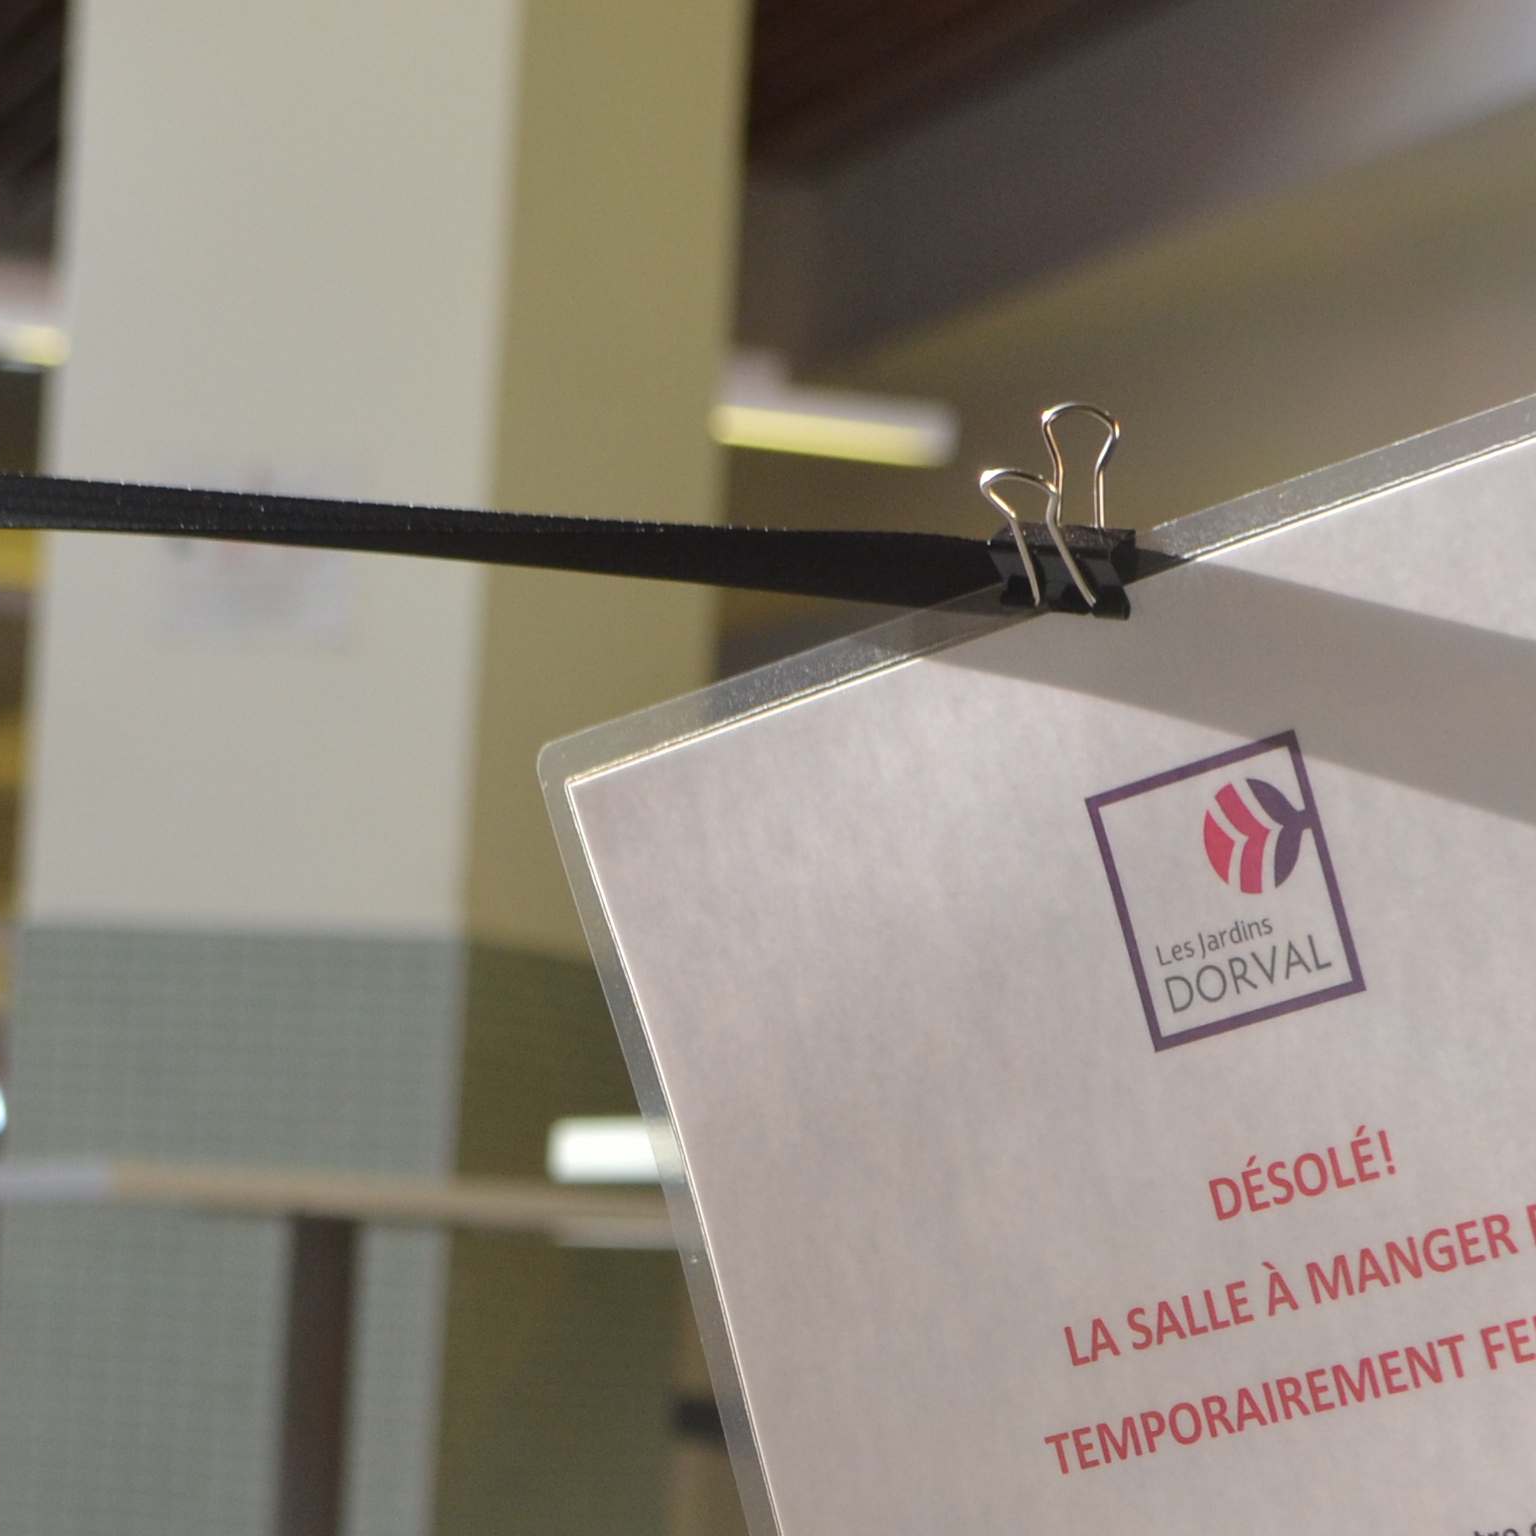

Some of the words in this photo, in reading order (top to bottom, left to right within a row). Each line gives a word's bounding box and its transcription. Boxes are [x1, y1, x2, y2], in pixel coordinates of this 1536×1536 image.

[1155, 940, 1196, 967] Les
[1197, 917, 1274, 960] Jardins
[1164, 934, 1333, 1014] DORVAL
[1207, 1124, 1397, 1222] DÉSOLÉ!
[1063, 1317, 1122, 1367] LA
[1126, 1279, 1255, 1351] SALLE
[1261, 1260, 1300, 1317] À
[1305, 1213, 1520, 1305] MANGER
[1043, 1333, 1466, 1475] TEMPORAIREMENT
